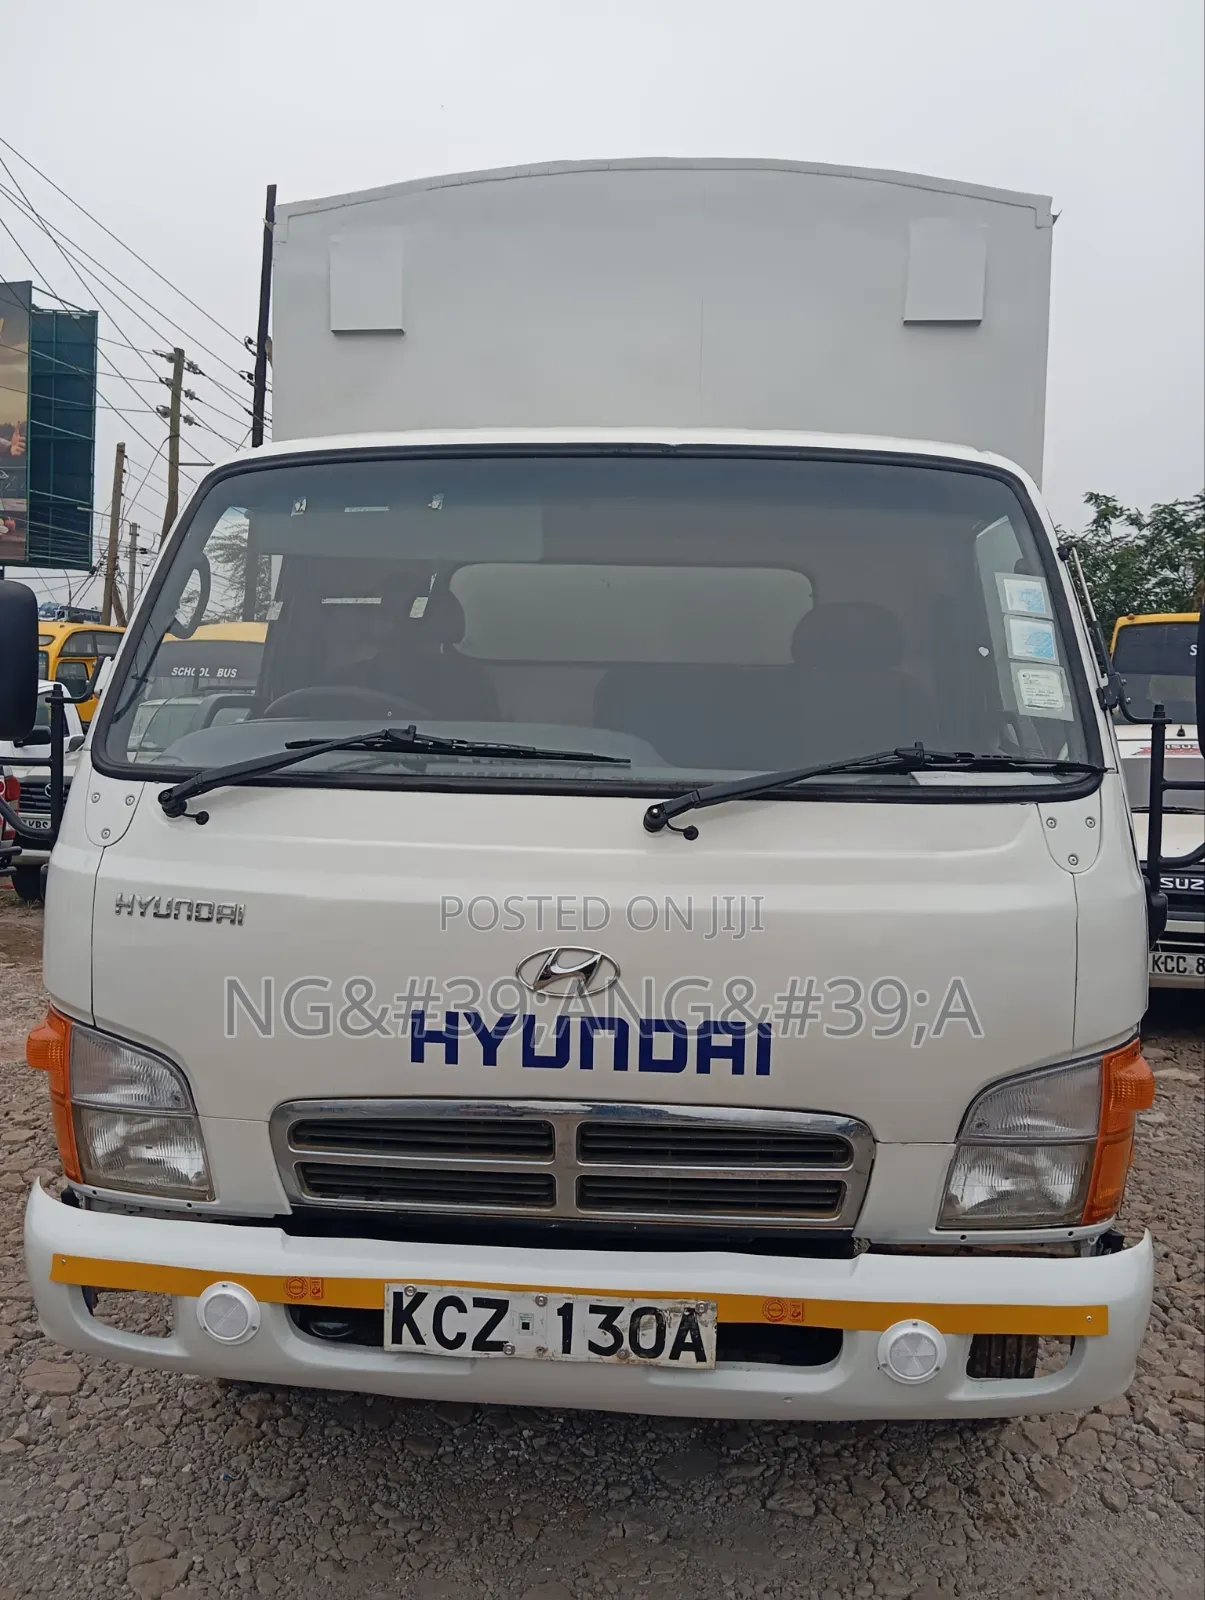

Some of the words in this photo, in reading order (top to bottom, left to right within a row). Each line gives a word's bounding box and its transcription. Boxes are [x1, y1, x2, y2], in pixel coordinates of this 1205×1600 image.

[216, 668, 238, 678] BUS
[1160, 877, 1204, 890] SUZ
[115, 892, 246, 926] HYUNDAI
[1152, 954, 1187, 974] KCC
[410, 1009, 772, 1077] HYUNDAI
[391, 1291, 509, 1352] KCZ
[556, 1302, 707, 1363] 130A
